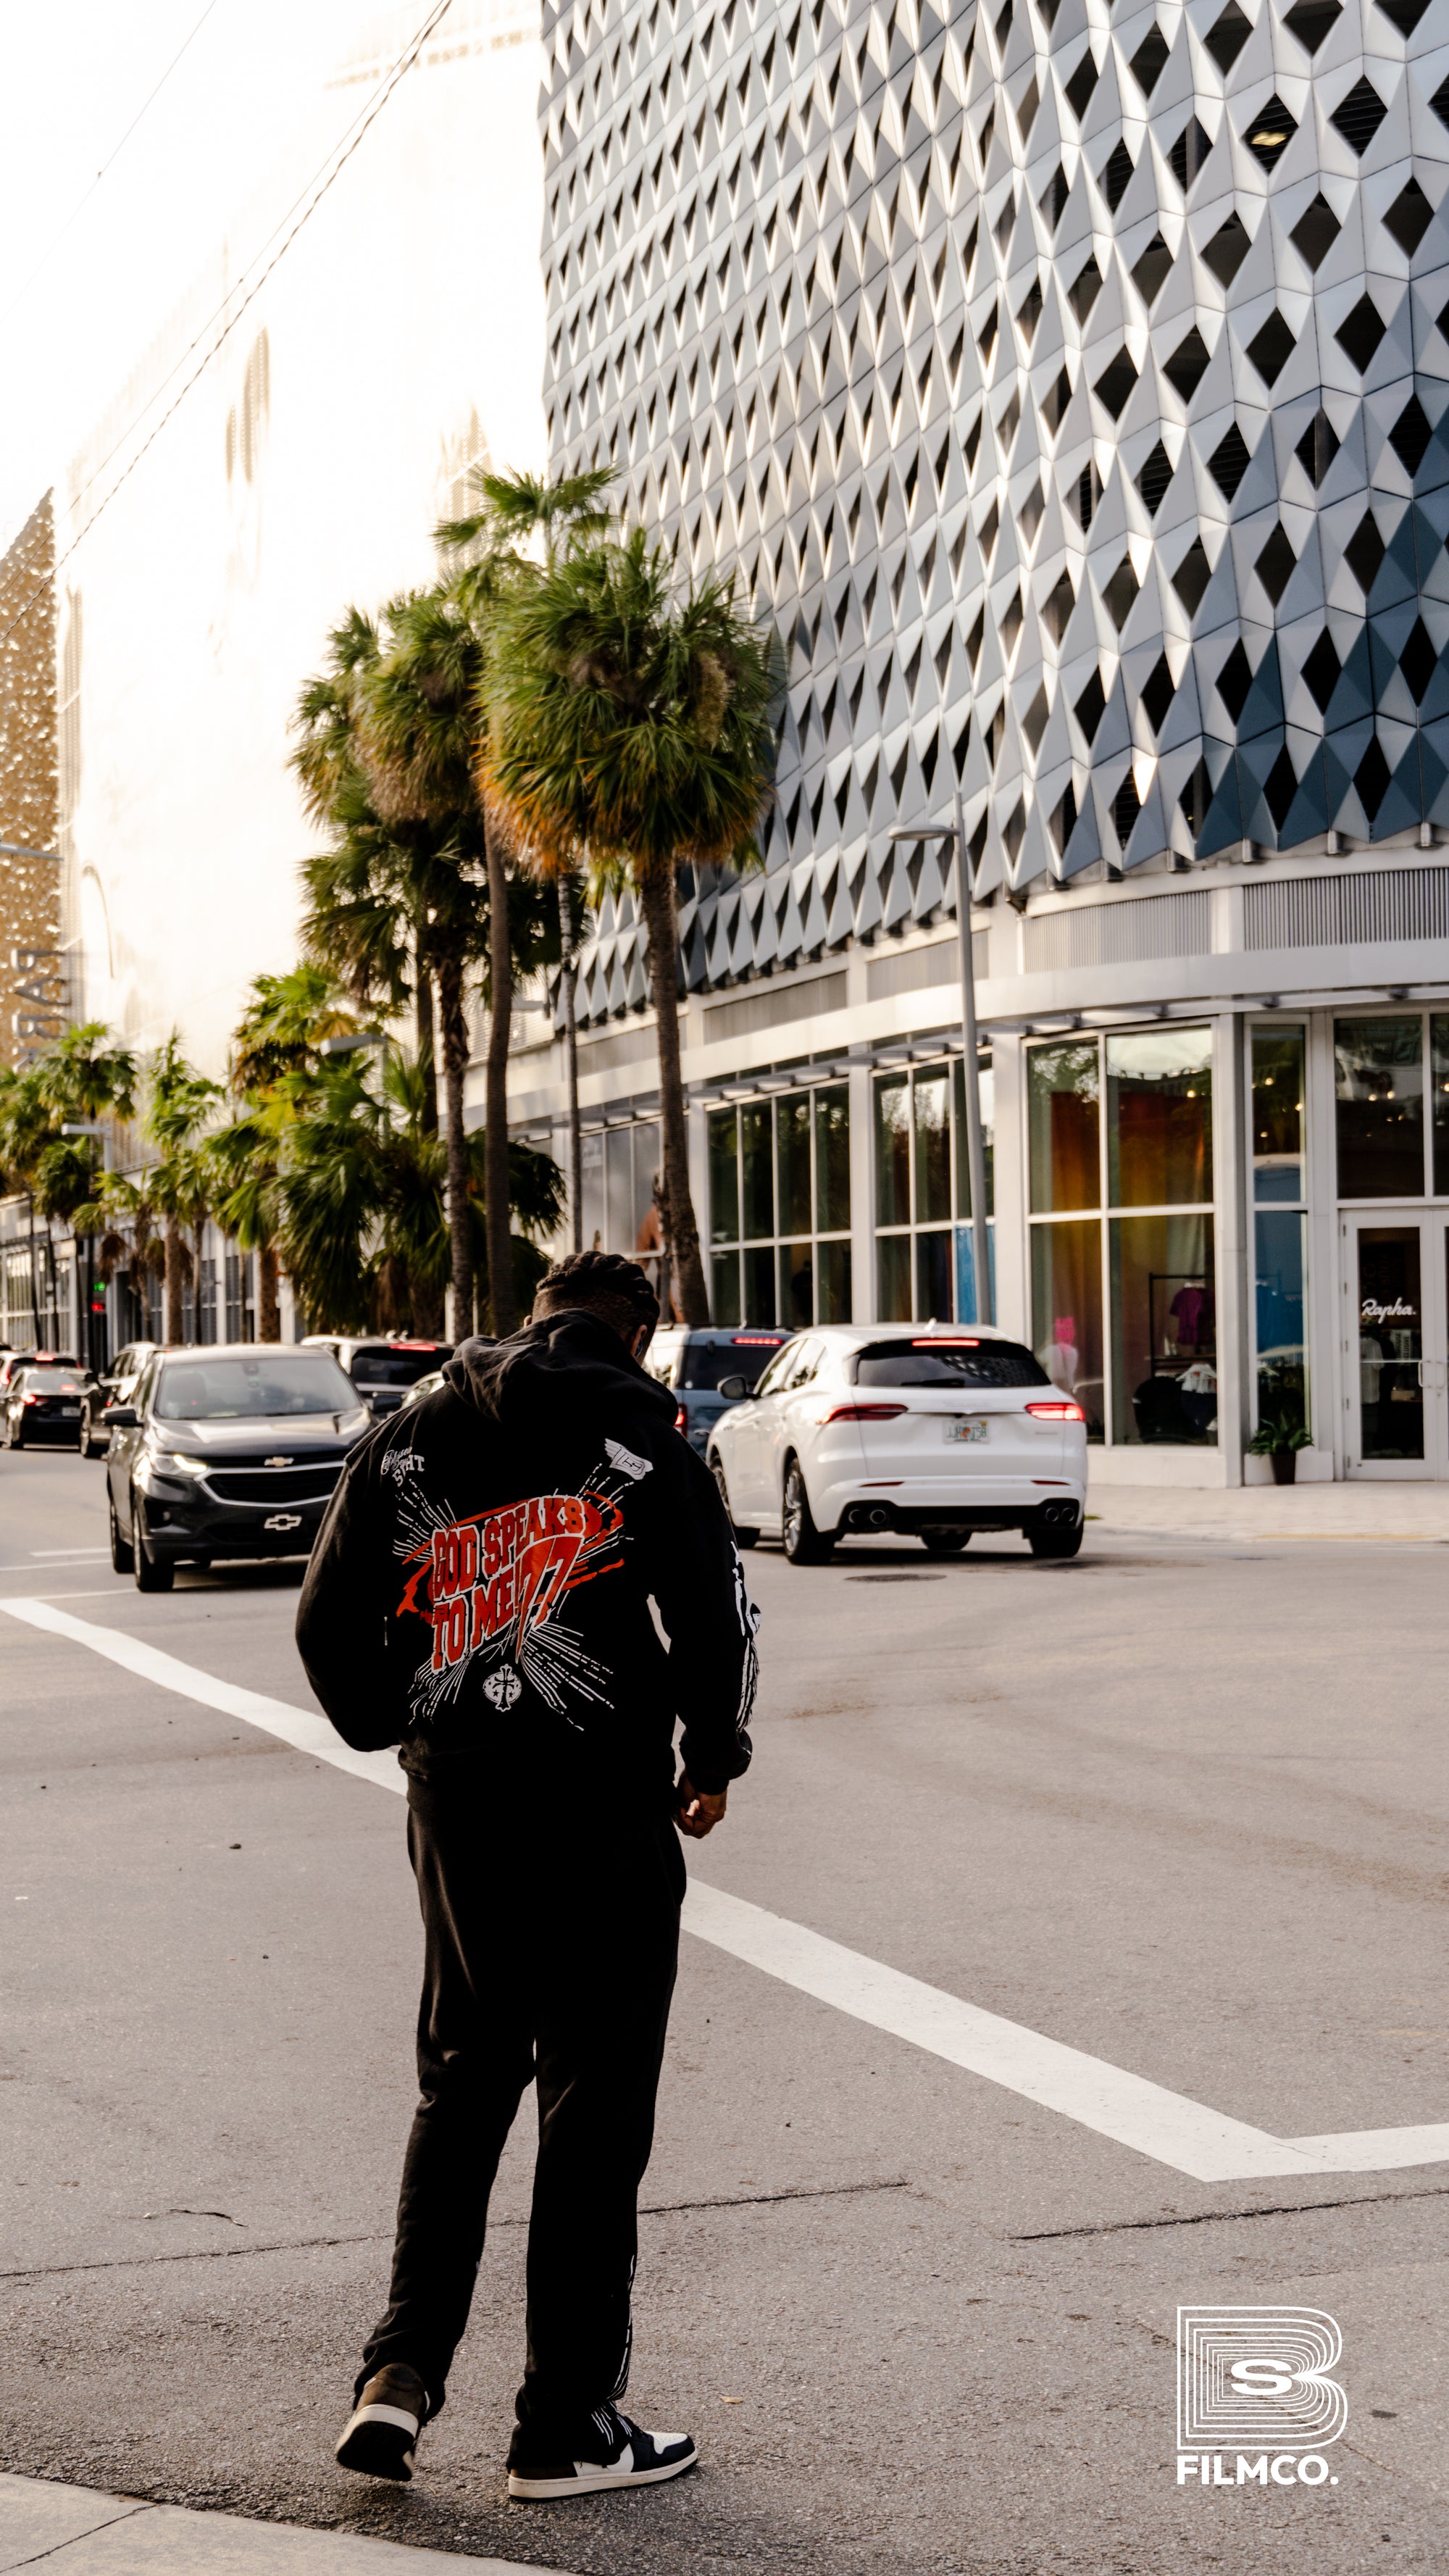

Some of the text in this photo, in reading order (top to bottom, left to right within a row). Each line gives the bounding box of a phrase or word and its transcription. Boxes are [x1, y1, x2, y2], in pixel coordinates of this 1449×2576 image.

[432, 1495, 585, 1601] GOD SPEAKS
[432, 1594, 469, 1674] TO
[470, 1565, 516, 1655] ME
